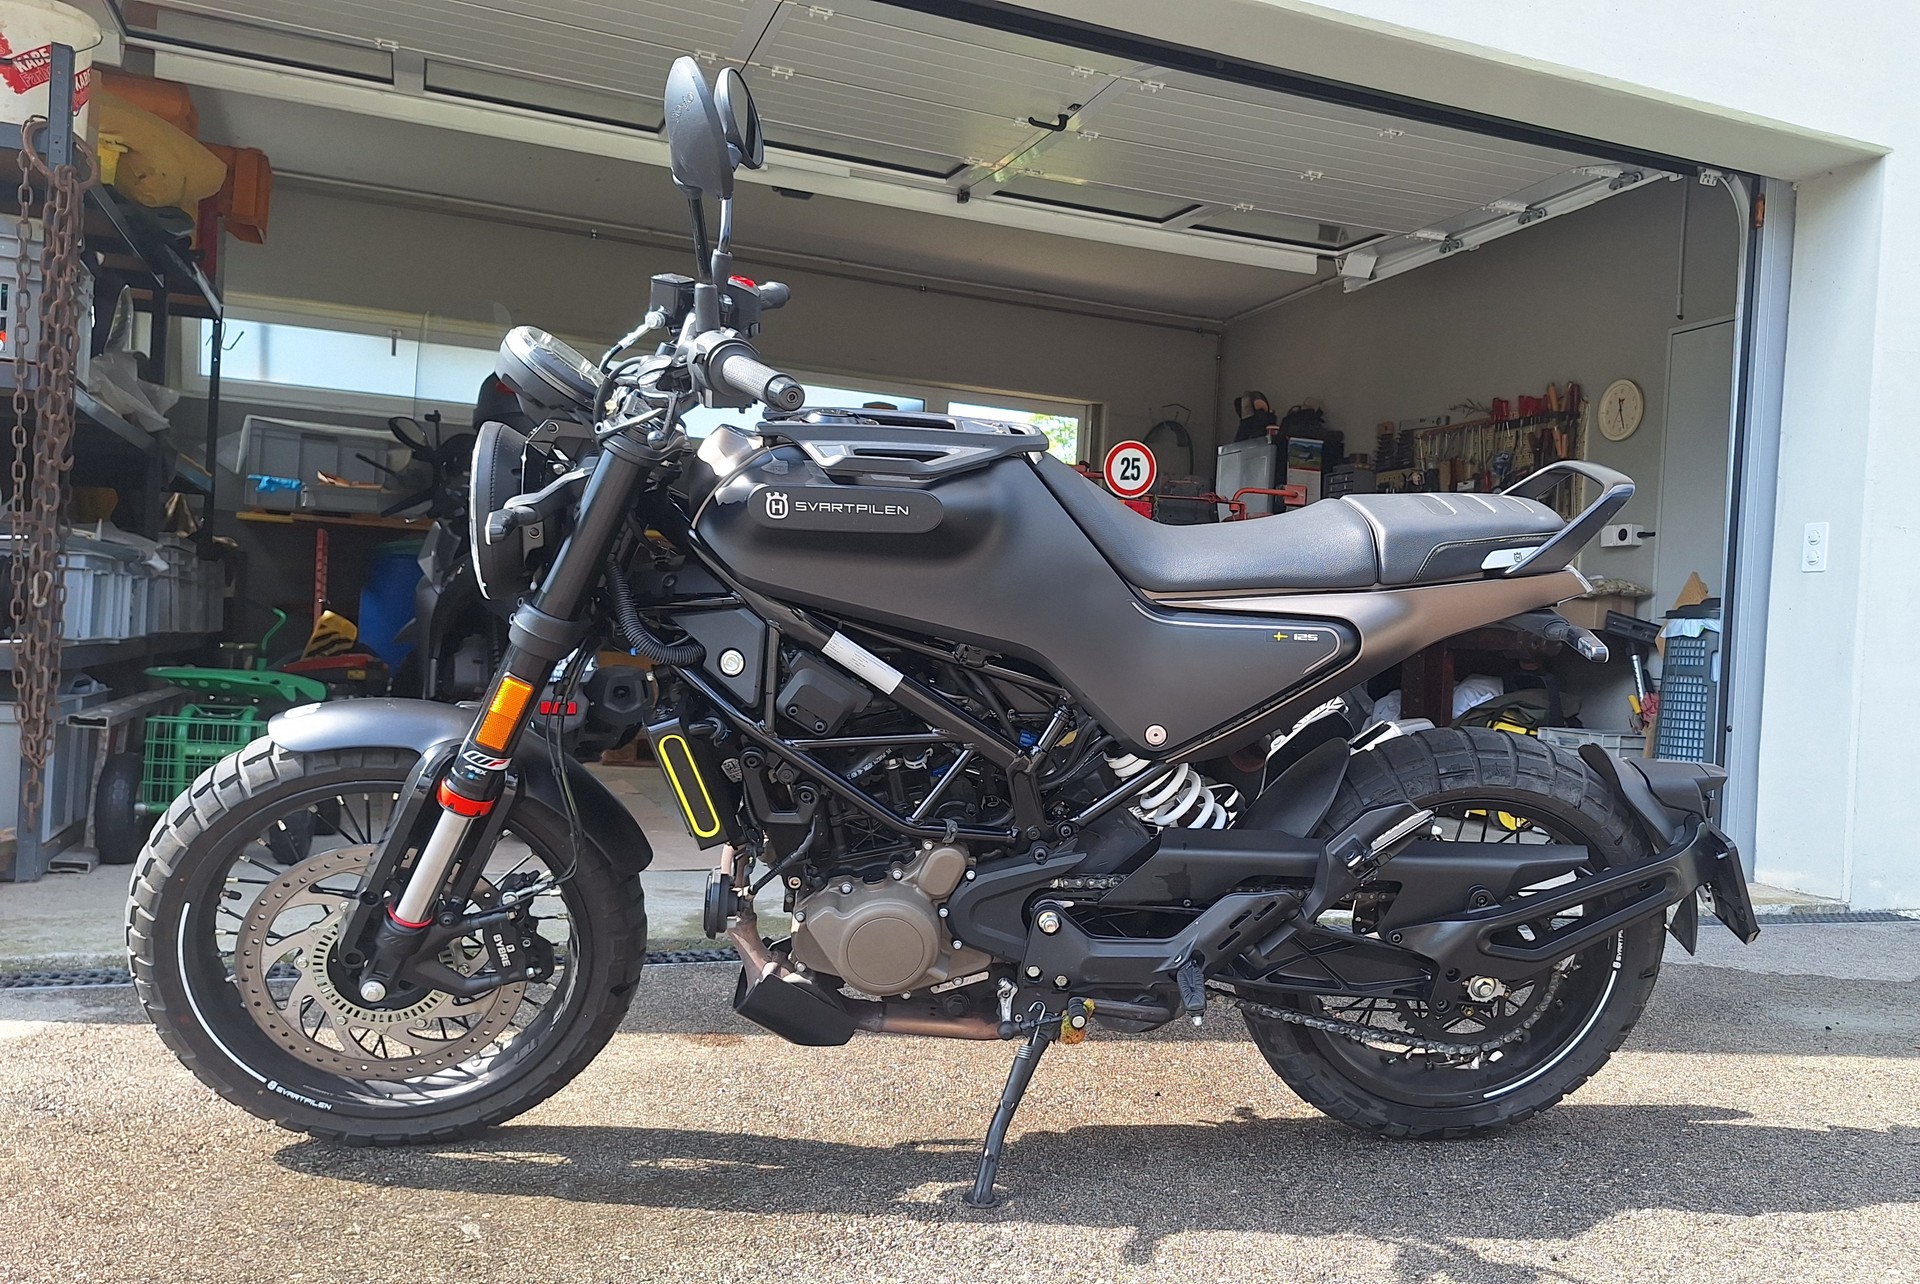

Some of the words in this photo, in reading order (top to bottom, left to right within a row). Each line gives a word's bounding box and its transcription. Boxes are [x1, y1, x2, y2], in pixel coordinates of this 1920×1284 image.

[13, 48, 50, 73] KABE
[1120, 457, 1140, 481] 25
[795, 501, 909, 515] SVARTPILEN
[1293, 633, 1318, 641] 125
[493, 934, 511, 967] BYBRE
[275, 1086, 332, 1111] SVARTPILEN
